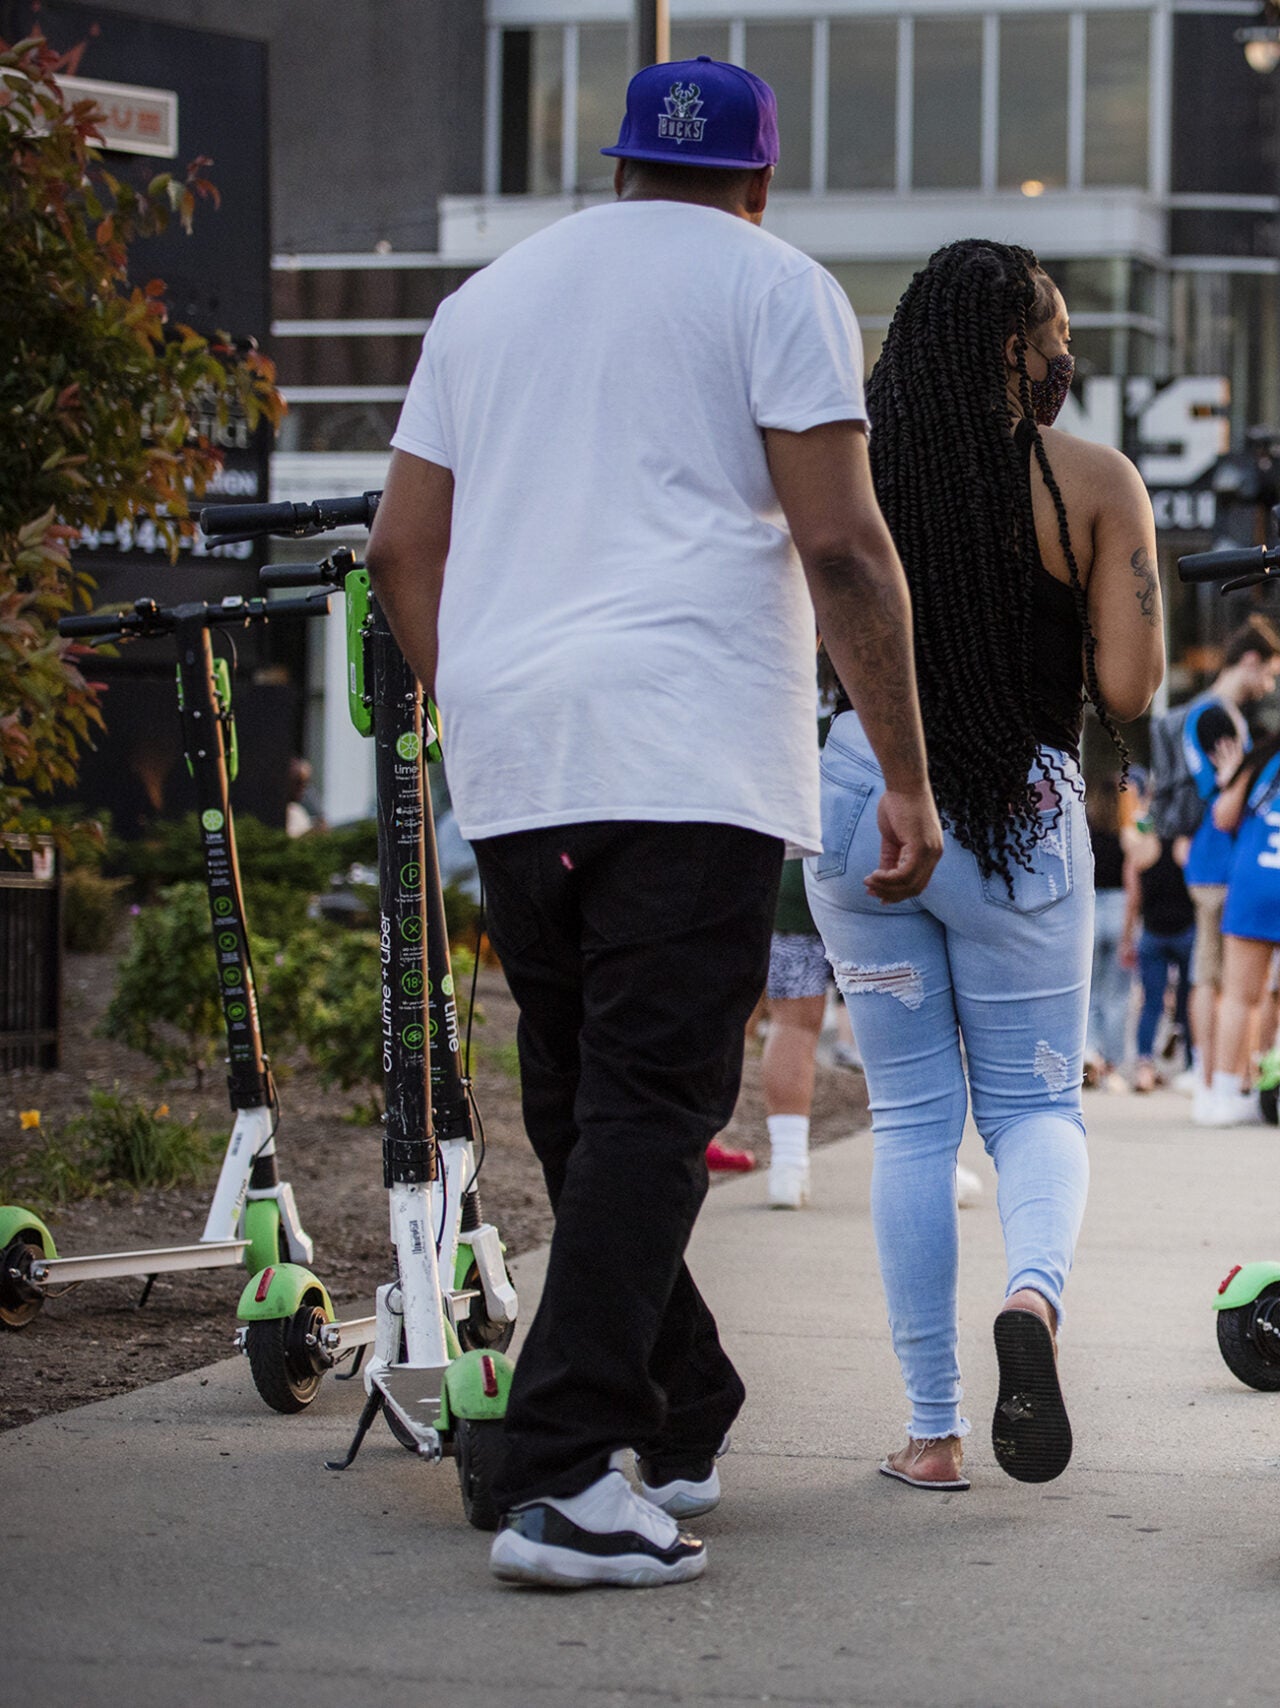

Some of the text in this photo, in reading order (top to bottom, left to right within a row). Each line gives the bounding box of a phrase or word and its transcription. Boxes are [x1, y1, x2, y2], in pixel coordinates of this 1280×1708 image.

[660, 117, 701, 138] BUCKS
[380, 912, 391, 964] Uber
[382, 985, 392, 1037] Lime
[444, 1000, 459, 1053] Lime
[383, 1040, 392, 1073] On
